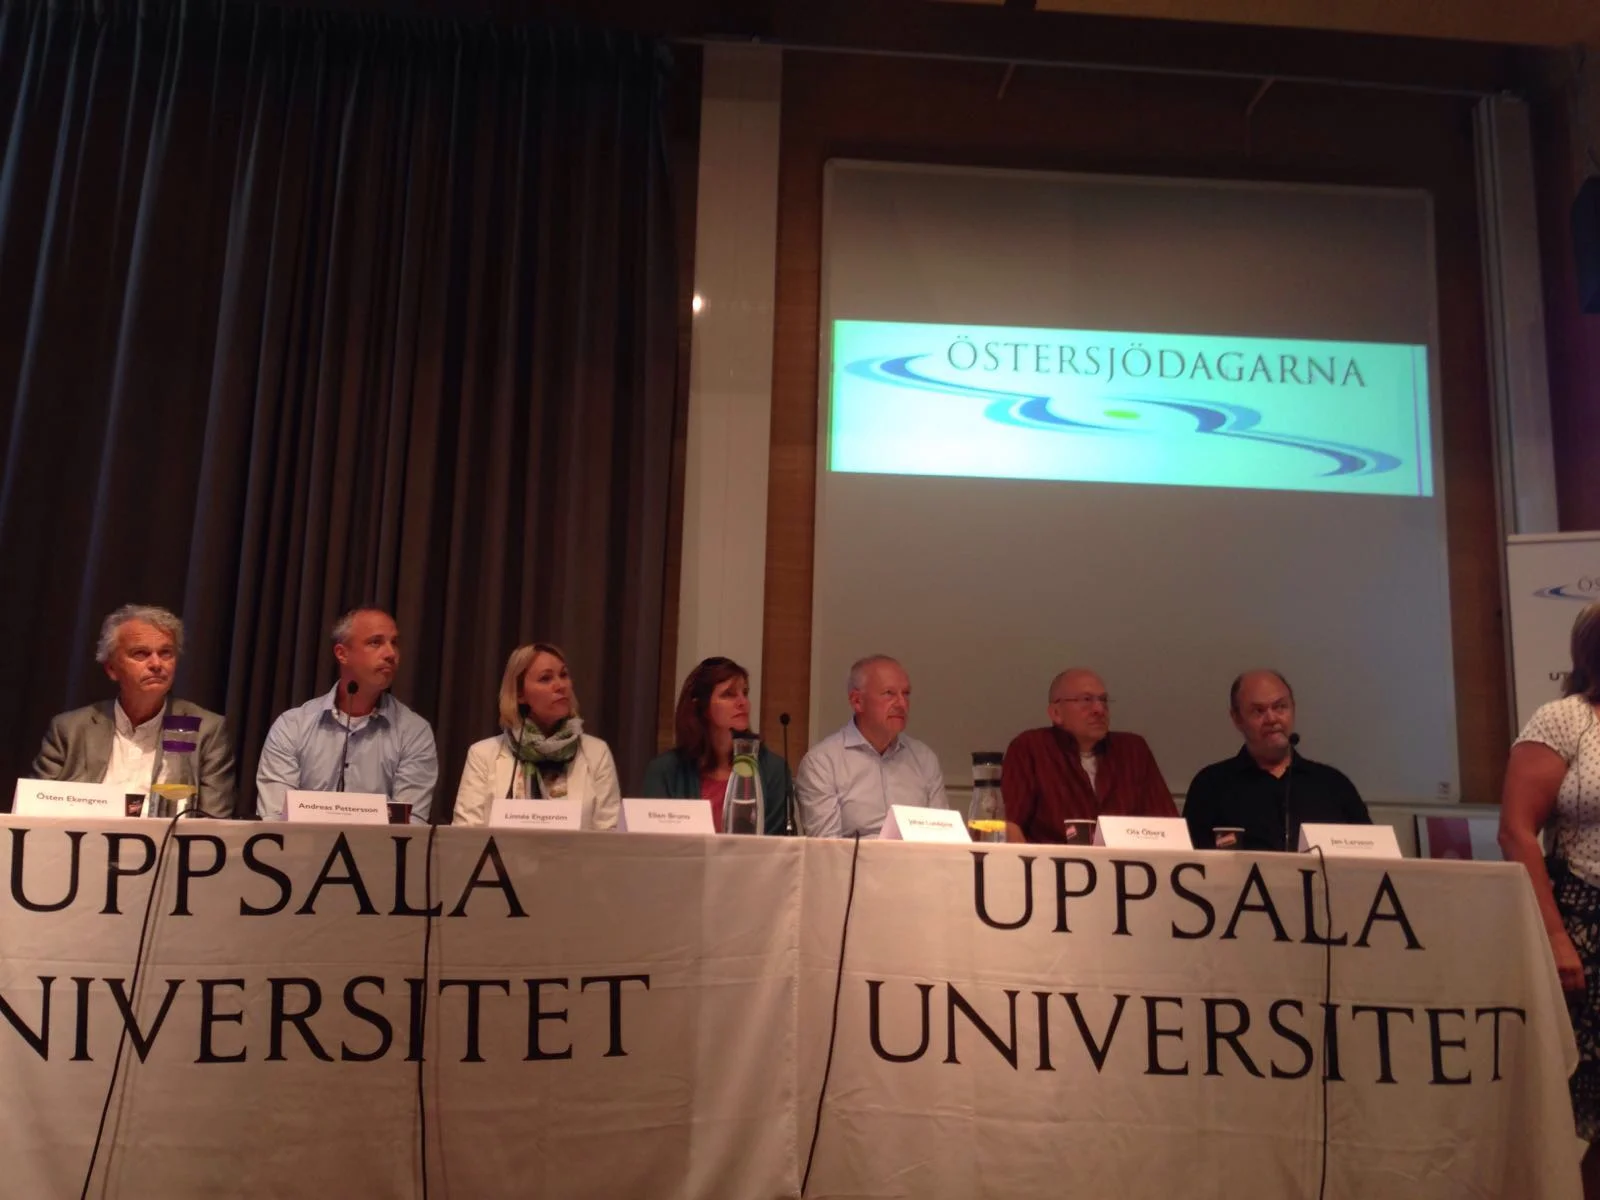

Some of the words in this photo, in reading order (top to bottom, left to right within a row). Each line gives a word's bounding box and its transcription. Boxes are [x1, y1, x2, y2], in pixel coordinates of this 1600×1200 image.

[947, 335, 1367, 387] ÖSTERSJÖDAGARNA
[36, 792, 64, 802] Östen
[298, 802, 333, 812] Andreas
[335, 804, 378, 814] Pettersson
[8, 828, 530, 918] UPPSALA
[970, 850, 1425, 951] UPPSALA
[866, 979, 1526, 1086] UNIVERSITET
